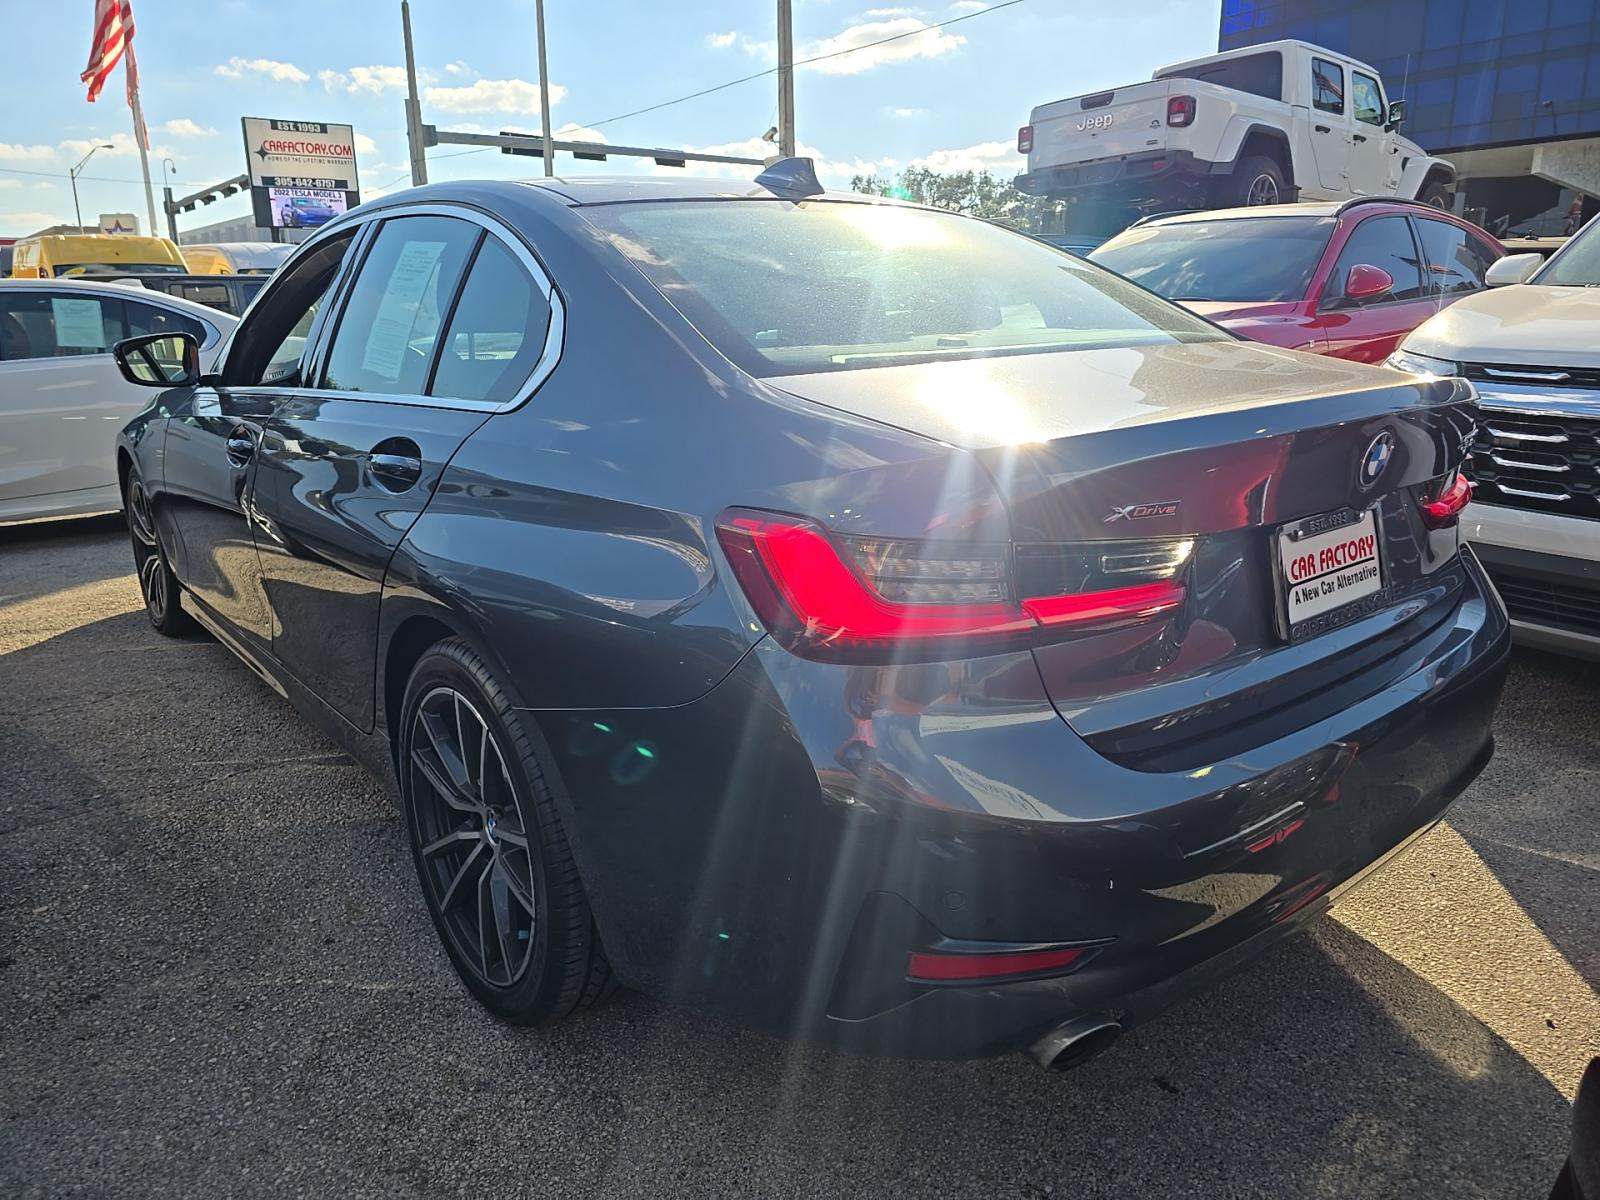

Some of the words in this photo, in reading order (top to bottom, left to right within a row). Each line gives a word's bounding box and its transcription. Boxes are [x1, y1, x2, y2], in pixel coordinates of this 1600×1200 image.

[297, 123, 320, 133] 1993
[1076, 112, 1113, 132] Jeep
[263, 140, 352, 156] CARFACTORY.COM
[291, 189, 312, 197] TESLA
[1328, 512, 1348, 525] 1993
[1290, 553, 1316, 581] CAR
[1319, 534, 1374, 572] FACTORY
[1295, 590, 1302, 605] A
[1303, 583, 1320, 603] New
[1320, 580, 1335, 596] Car
[1337, 566, 1378, 589] Alternative
